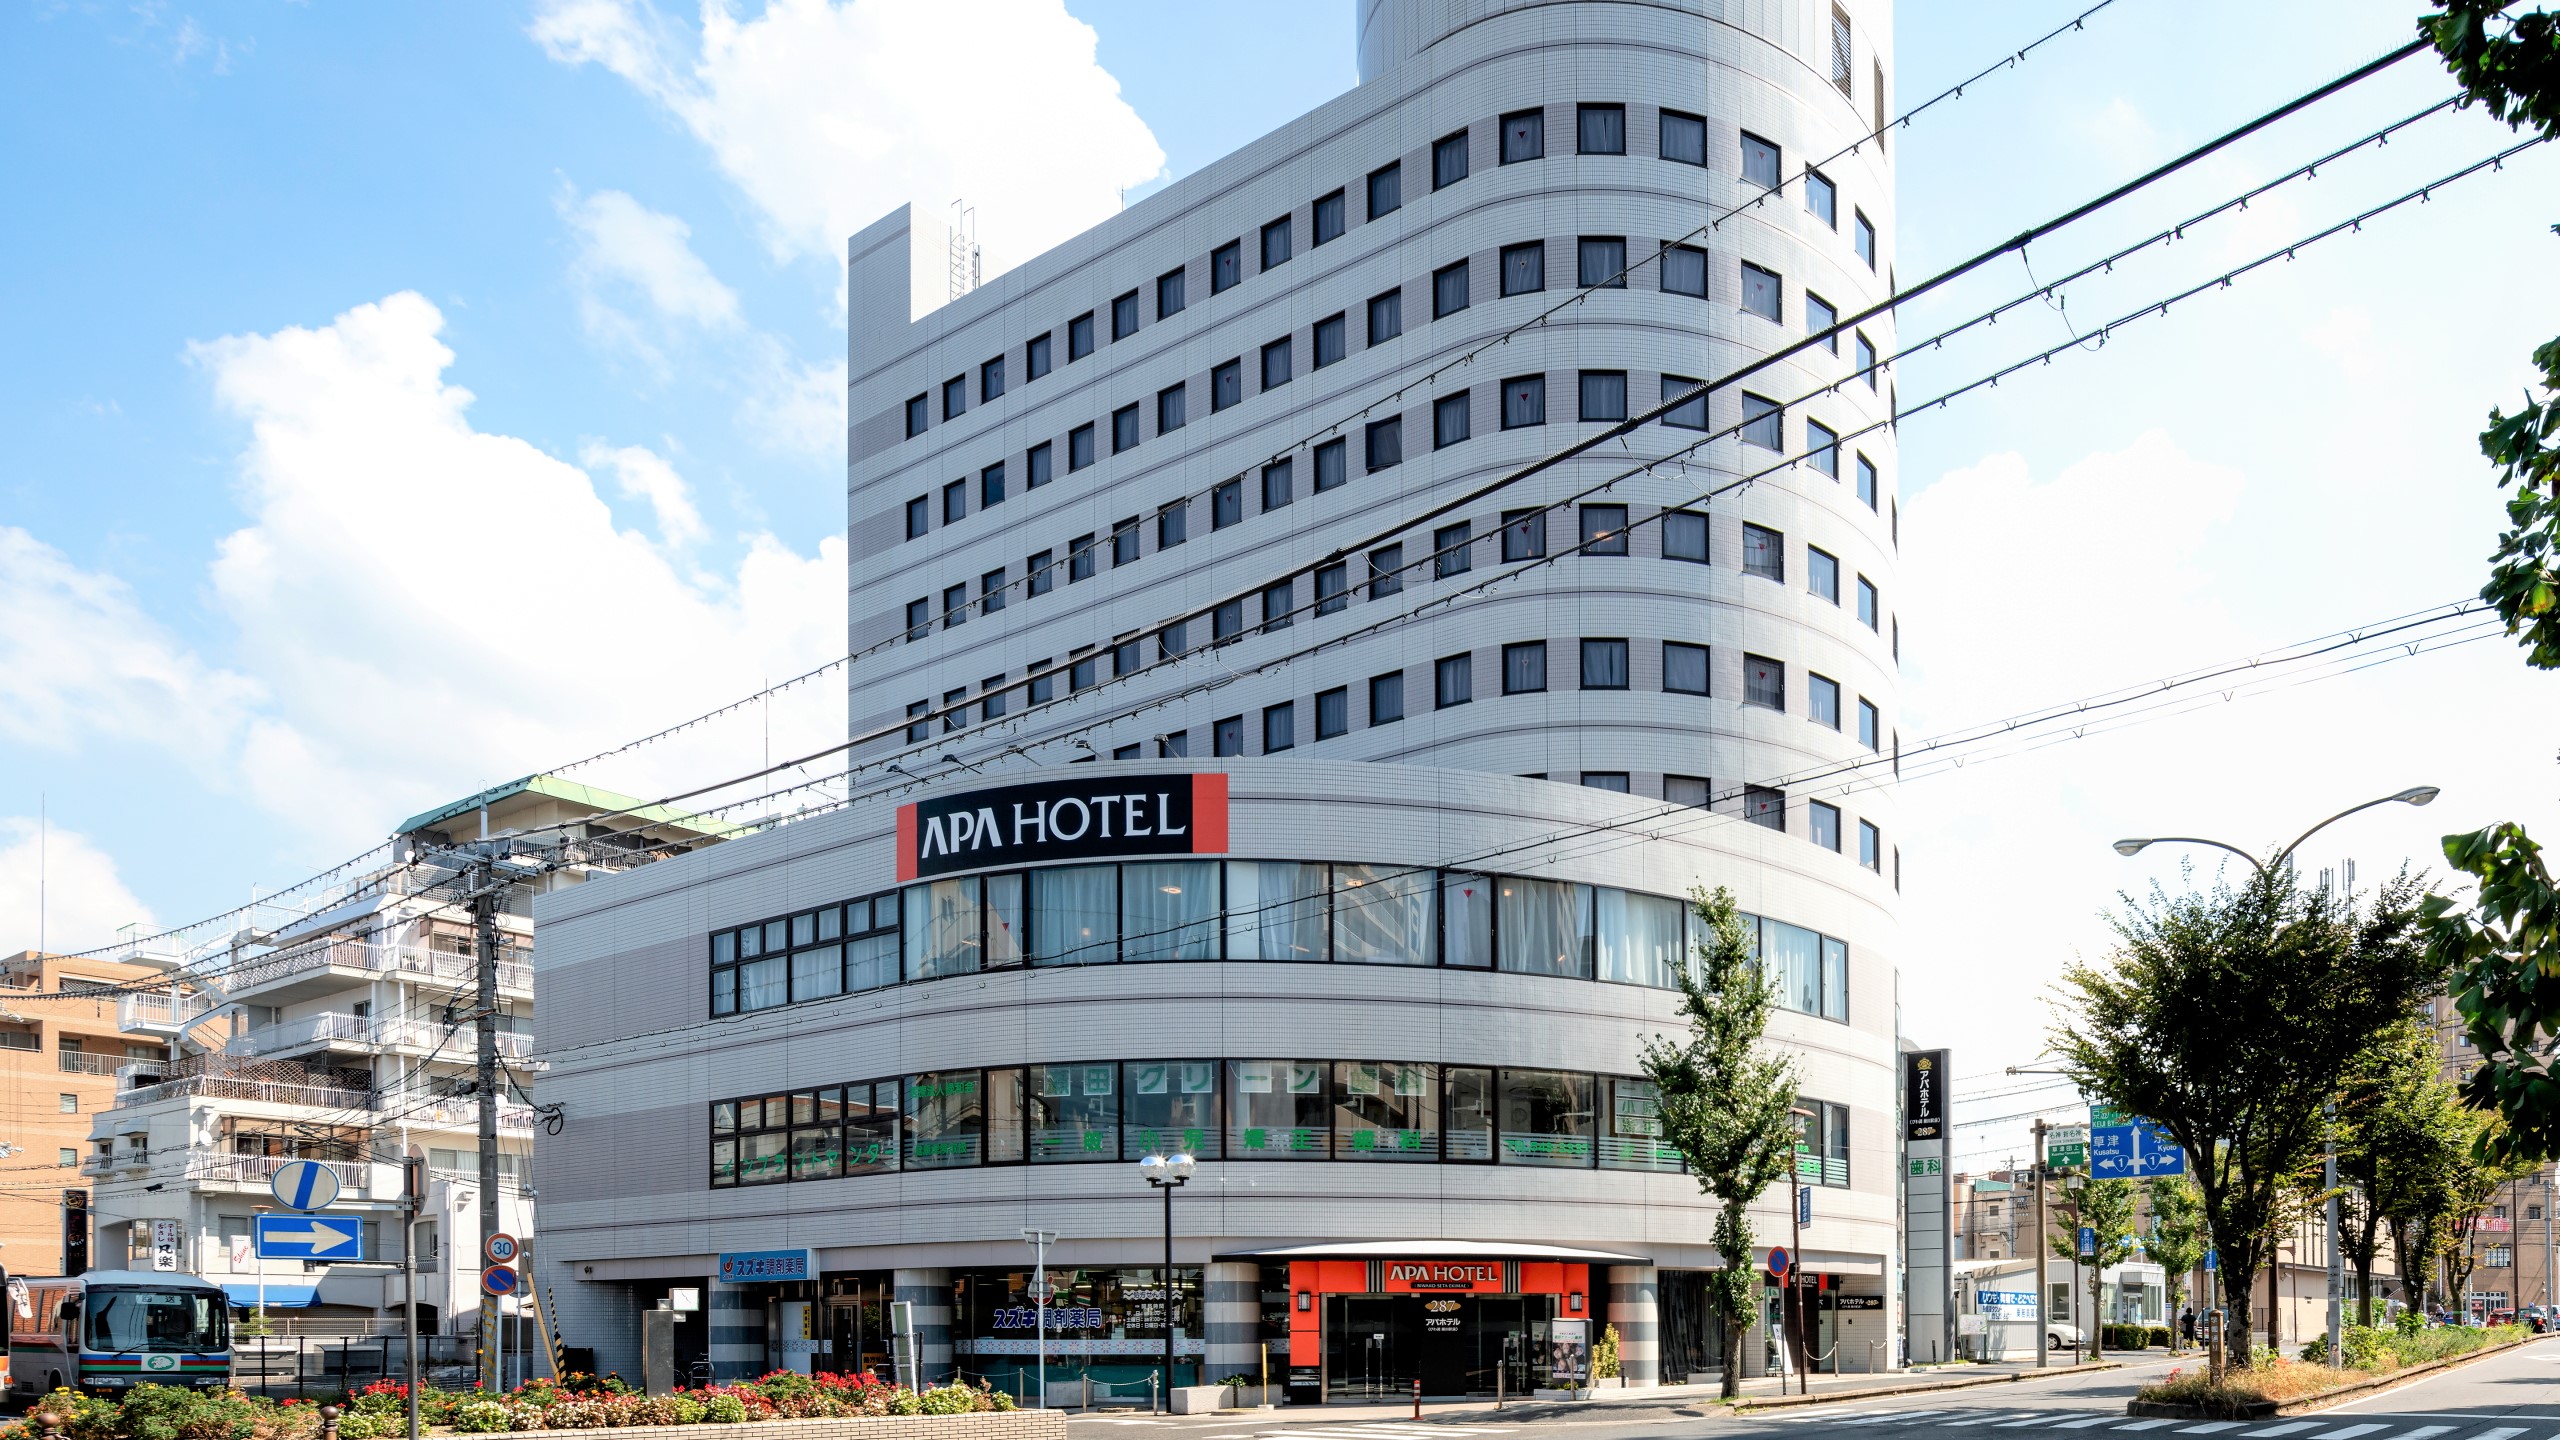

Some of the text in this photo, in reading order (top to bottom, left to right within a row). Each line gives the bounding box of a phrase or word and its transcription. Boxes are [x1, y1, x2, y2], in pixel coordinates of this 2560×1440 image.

[921, 793, 1187, 859] APA HOTEL
[1919, 1070, 1930, 1118] アパホテル
[1917, 1127, 1933, 1137] 287
[2093, 1134, 2120, 1148] 草津
[2157, 1144, 2177, 1153] Kyoto
[2093, 1148, 2120, 1156] Kusatsu
[721, 1143, 898, 1177] インプラントセンター
[1910, 1159, 1942, 1175] 歯科
[2119, 1155, 2155, 1168] 1 1
[493, 1241, 512, 1256] 30
[736, 1257, 804, 1276] スズキ調剤薬局
[1390, 1265, 1498, 1281] APA HOTEL
[1430, 1300, 1456, 1313] 287
[993, 1305, 1102, 1329] スズキ調剤薬局
[1425, 1318, 1461, 1326] アパホテル
